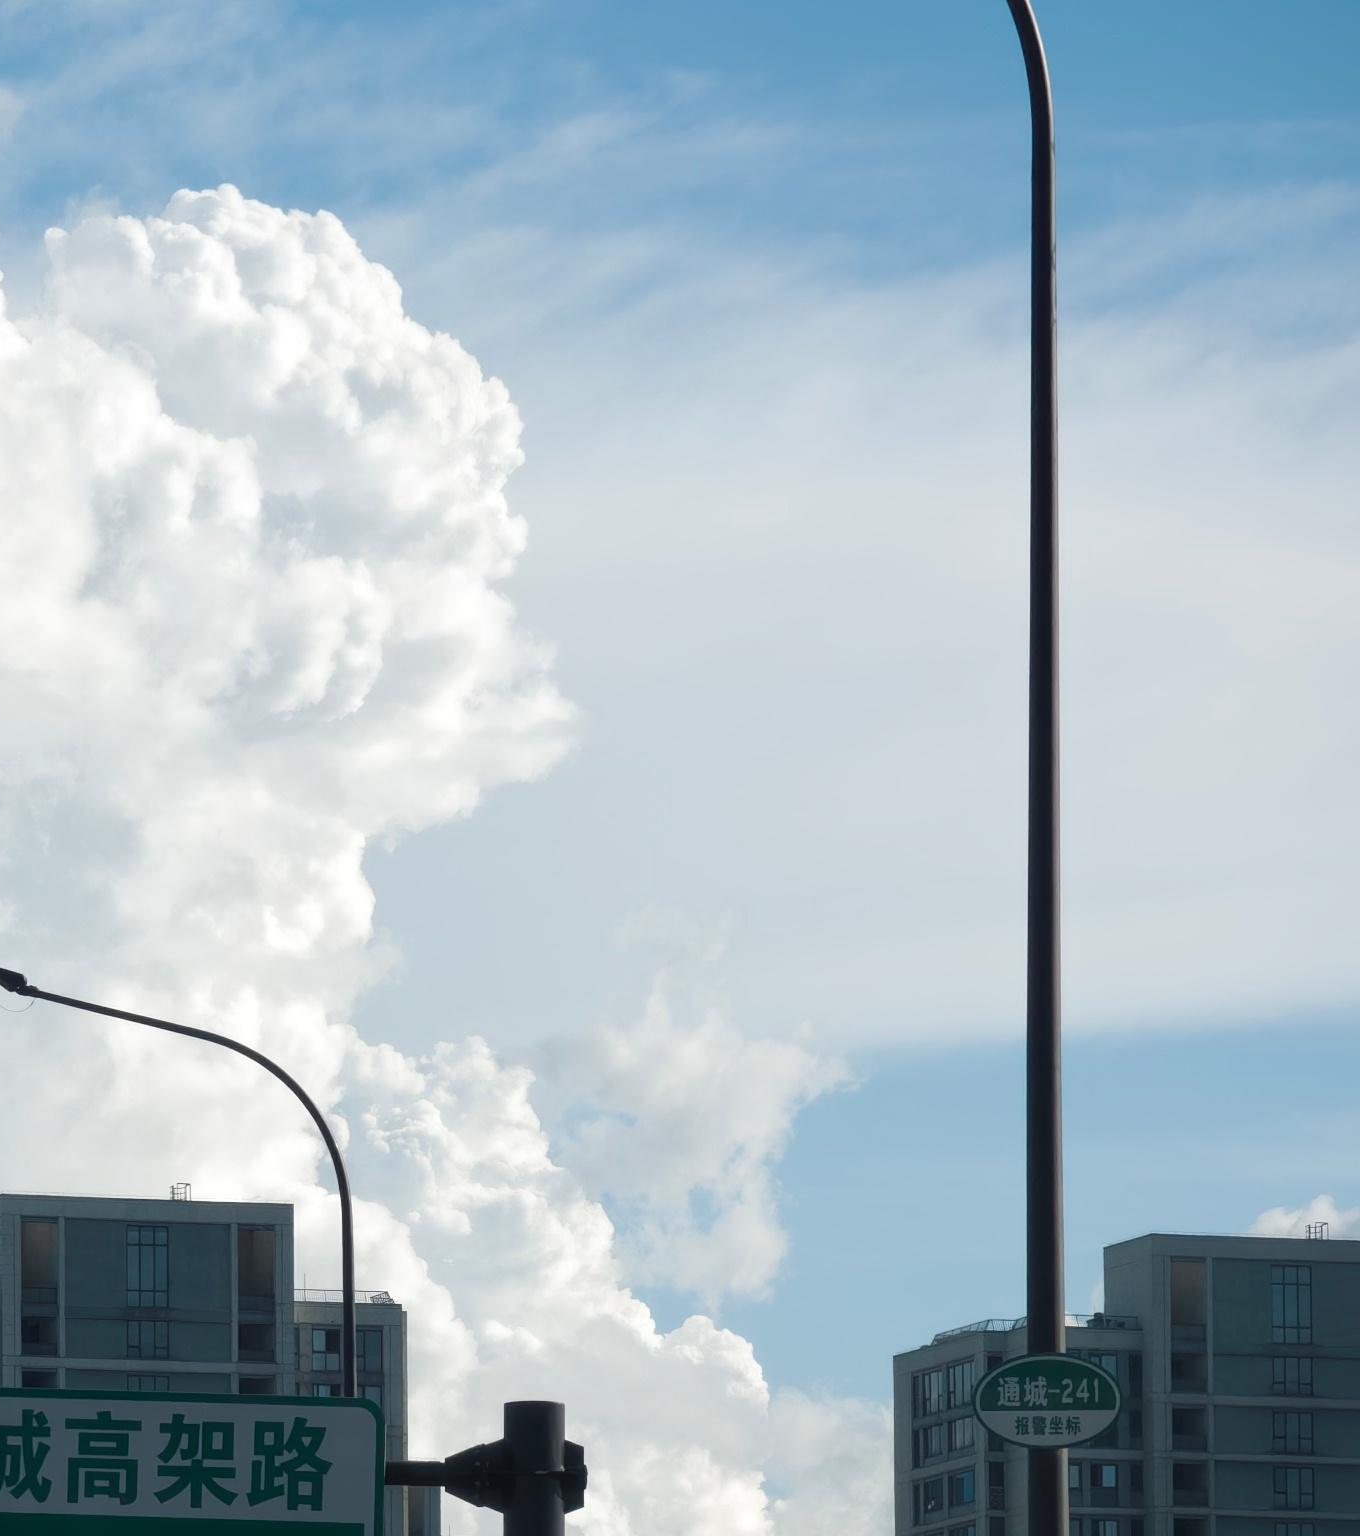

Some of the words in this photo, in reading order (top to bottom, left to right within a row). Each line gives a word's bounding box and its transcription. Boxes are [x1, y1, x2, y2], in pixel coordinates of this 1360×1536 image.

[997, 1375, 1099, 1408] 通城-241
[1015, 1415, 1082, 1436] 报警坐标
